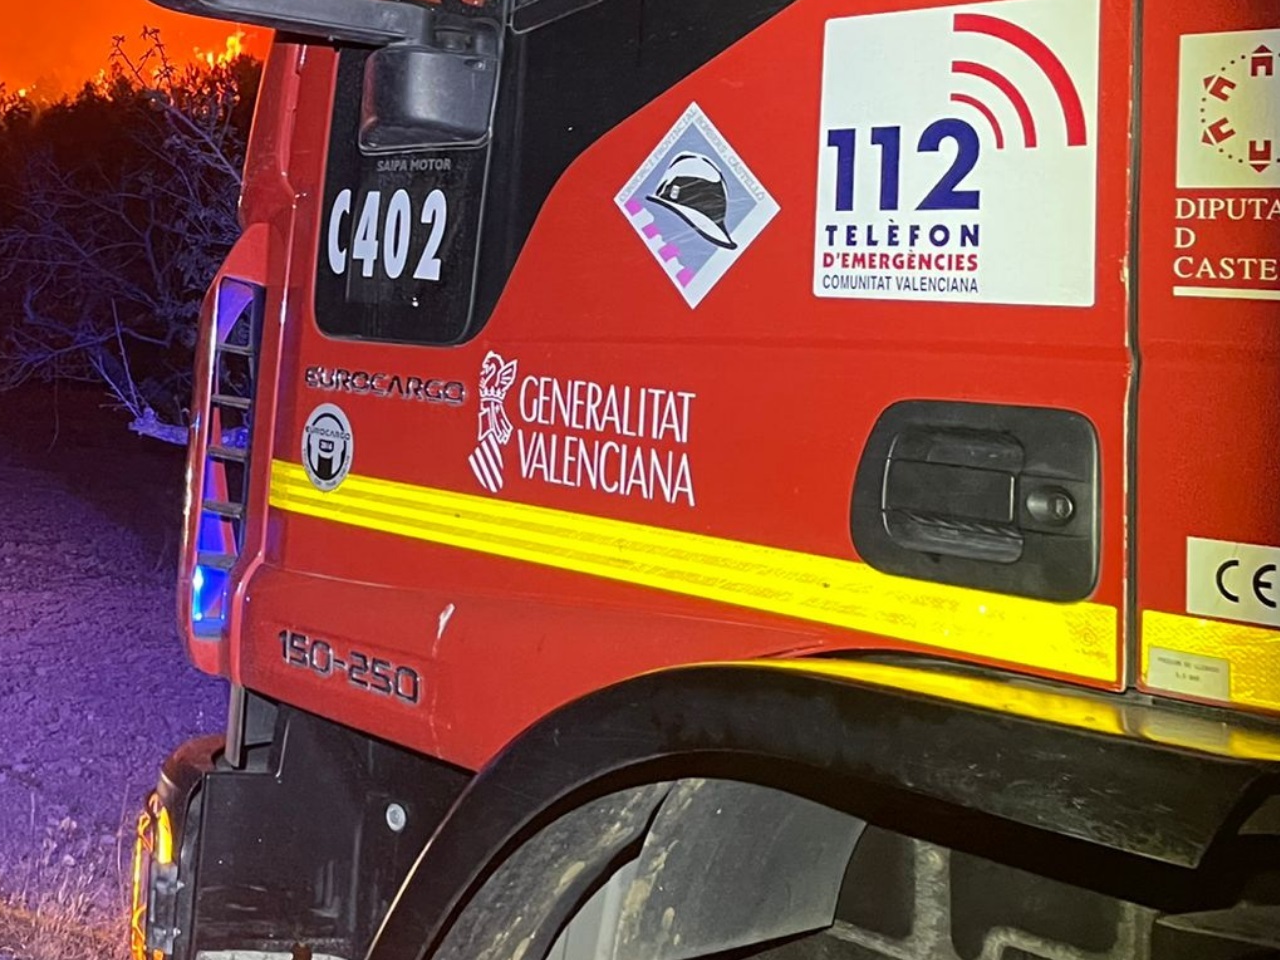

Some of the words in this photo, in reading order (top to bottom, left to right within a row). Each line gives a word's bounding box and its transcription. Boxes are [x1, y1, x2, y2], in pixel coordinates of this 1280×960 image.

[376, 159, 408, 172] SAIPA
[410, 158, 451, 171] MOTOR
[827, 117, 980, 211] 112
[1174, 197, 1280, 221] DIPUTA
[327, 188, 447, 281] C402
[825, 219, 979, 247] TELÈFON
[1174, 226, 1196, 249] D
[823, 249, 978, 271] D'EMERGÈNCIES
[1173, 255, 1278, 281] CASTE
[822, 274, 892, 291] COMUNITAT
[895, 275, 978, 293] VALENCIANA
[305, 365, 466, 406] EUROCARGO
[519, 375, 696, 443] GENERALITAT
[517, 429, 696, 507] VALENCIANA
[1215, 559, 1277, 609] CE
[279, 629, 421, 707] 150-250
